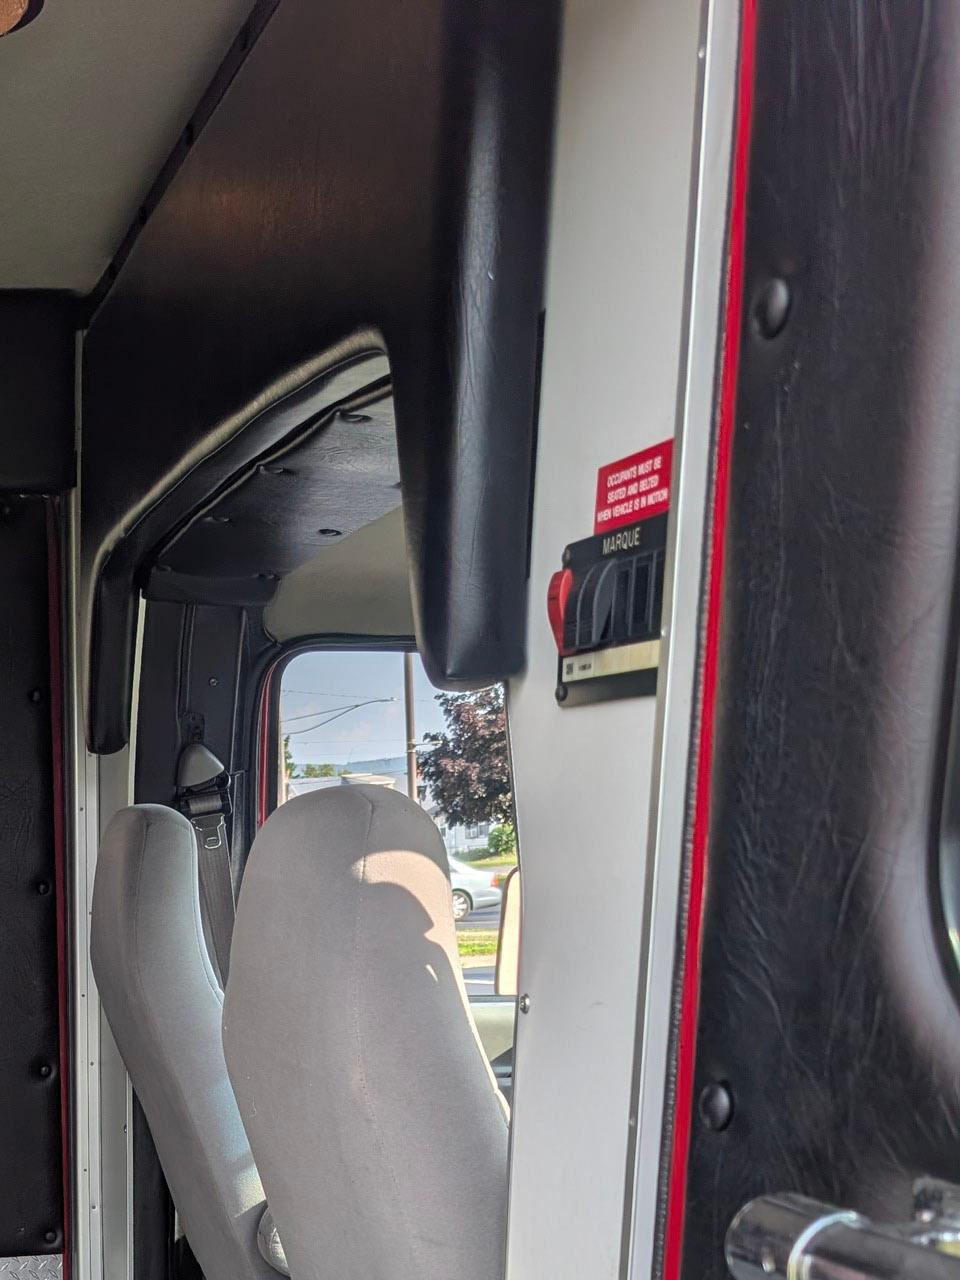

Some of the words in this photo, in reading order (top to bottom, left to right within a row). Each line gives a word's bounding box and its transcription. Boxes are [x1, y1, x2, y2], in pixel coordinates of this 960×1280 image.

[607, 465, 637, 488] OCCUPANTS
[638, 459, 653, 476] MUST
[653, 456, 662, 470] BE
[607, 487, 627, 504] SEATED
[627, 483, 638, 496] AND
[639, 475, 659, 492] BELTED
[597, 507, 612, 522] WHEN
[612, 500, 633, 518] VEHICLE
[633, 498, 640, 511] IS
[640, 496, 646, 507] IN
[647, 488, 668, 505] MOTION
[603, 528, 640, 554] MARQUE
